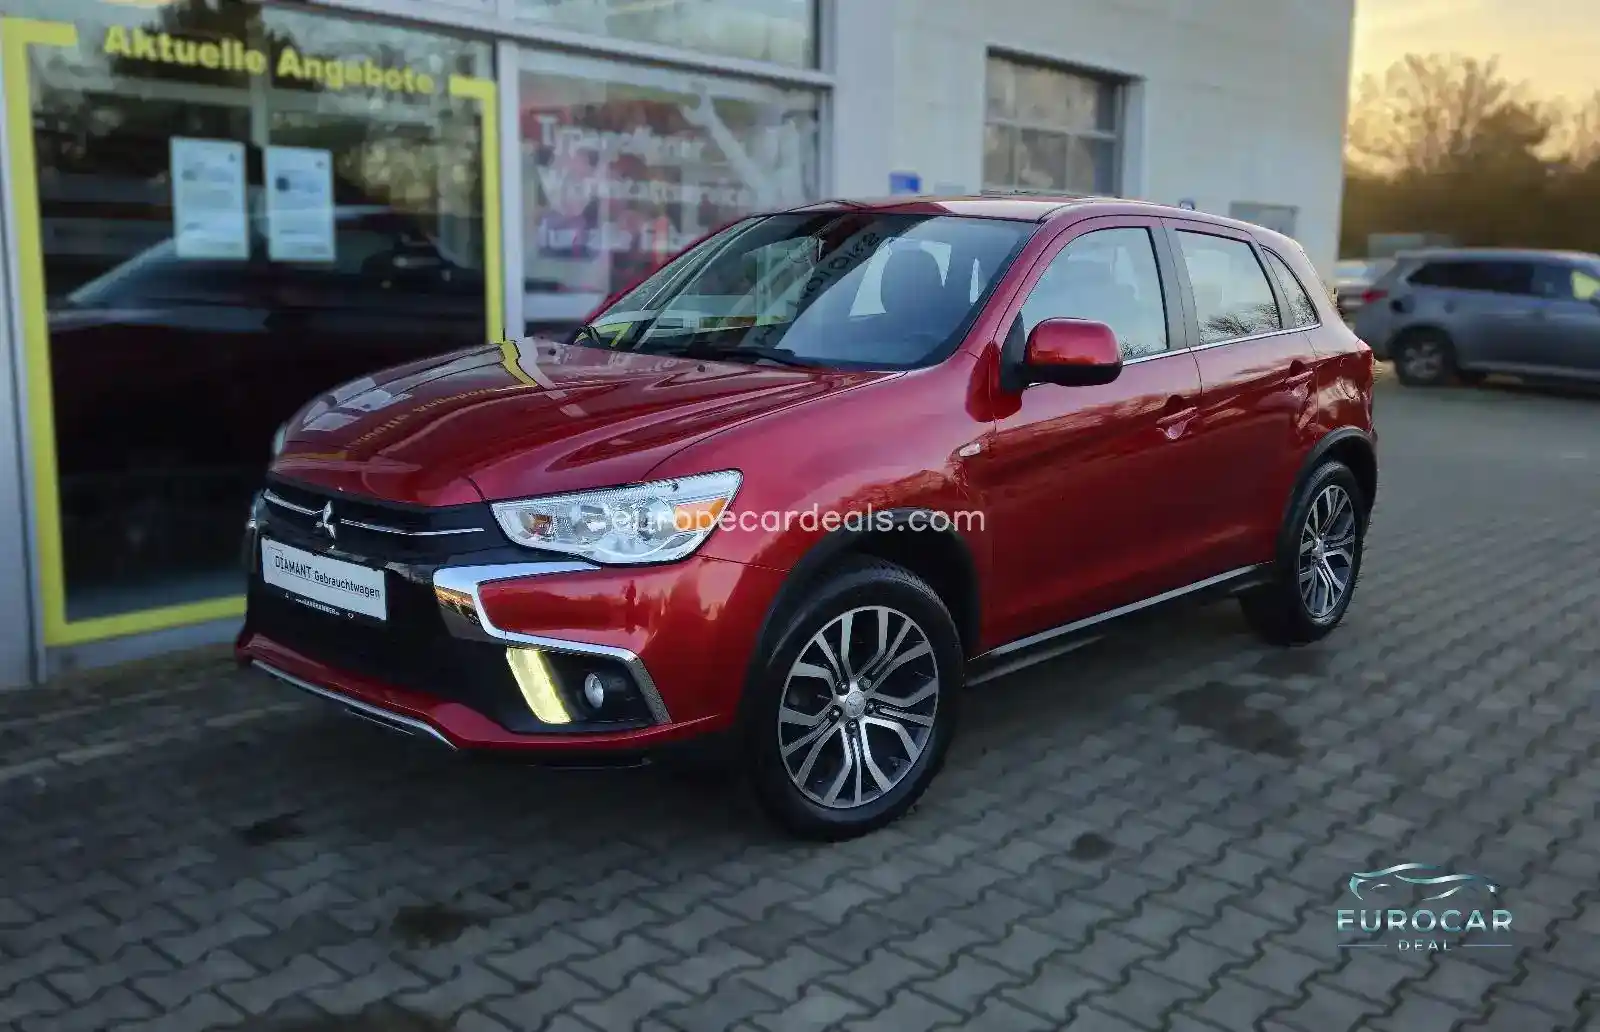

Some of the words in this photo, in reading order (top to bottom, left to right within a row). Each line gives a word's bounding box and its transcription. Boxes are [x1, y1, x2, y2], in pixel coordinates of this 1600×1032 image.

[104, 25, 267, 75] Aktuelle
[277, 46, 435, 93] Angebote
[275, 555, 312, 579] DIAMANT
[314, 571, 381, 599] Gebrauchtwagen
